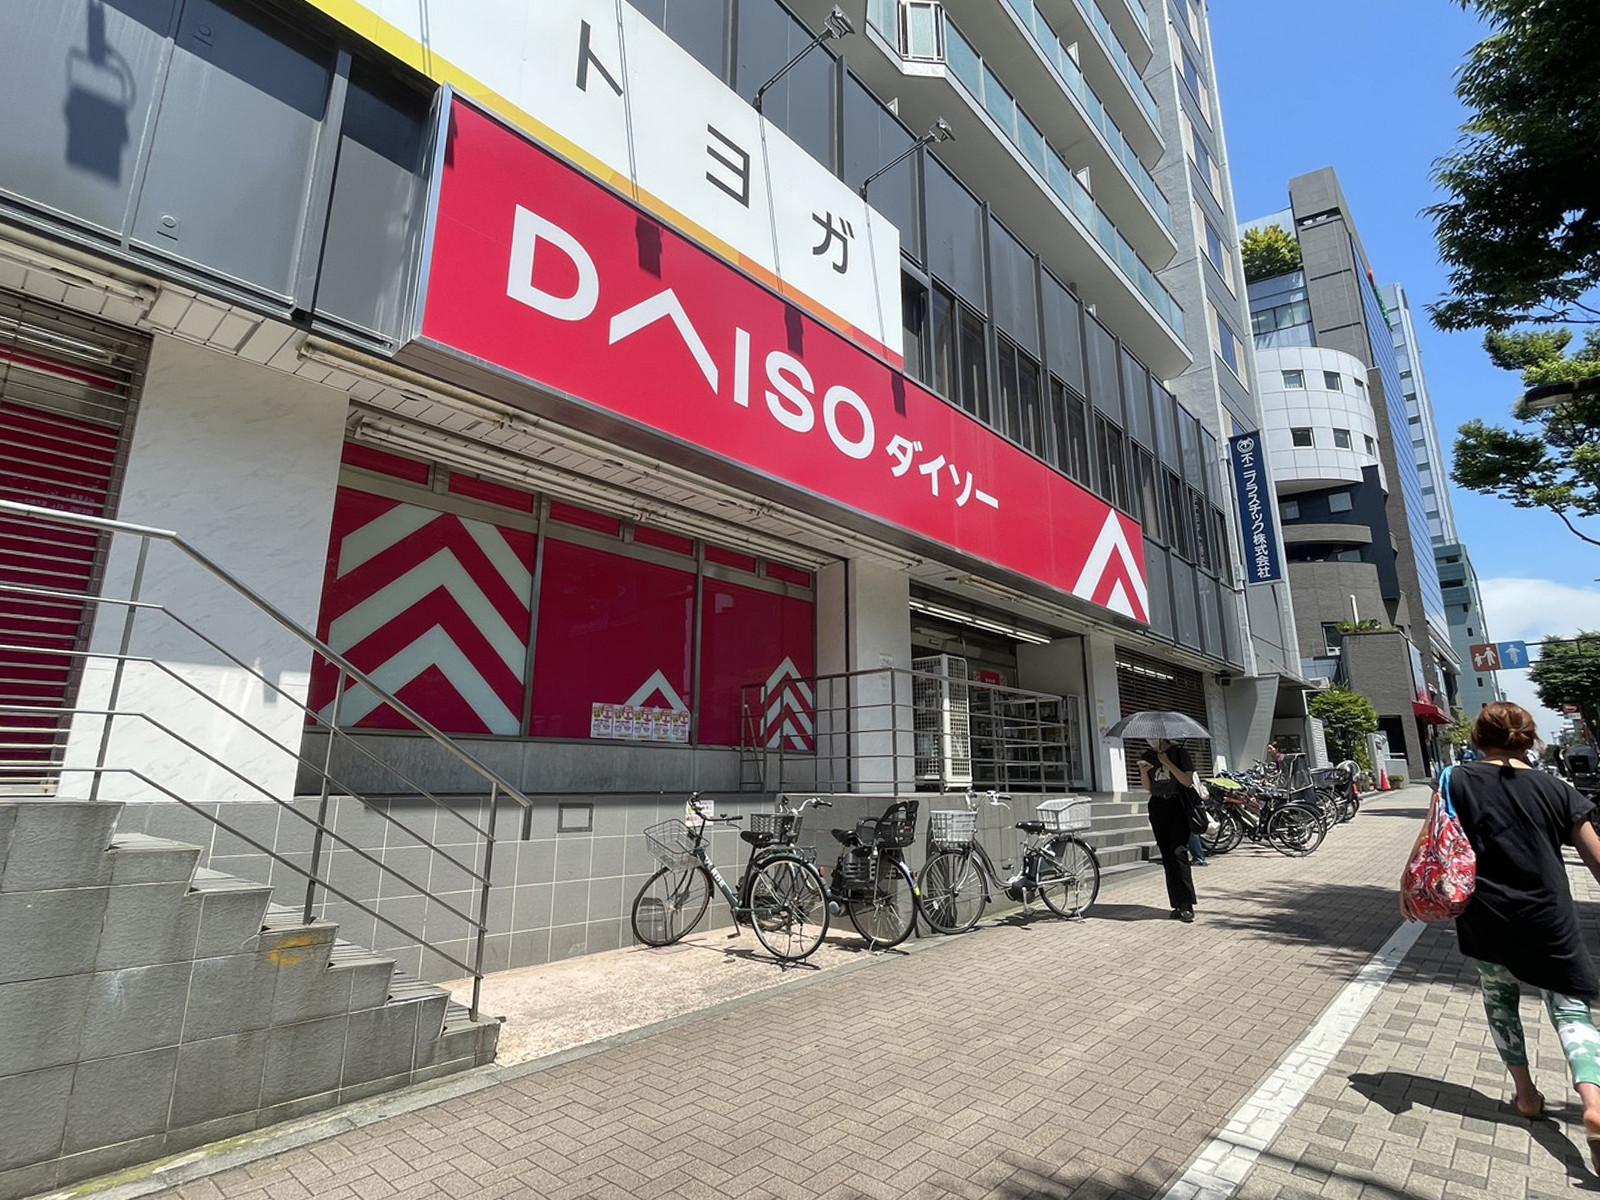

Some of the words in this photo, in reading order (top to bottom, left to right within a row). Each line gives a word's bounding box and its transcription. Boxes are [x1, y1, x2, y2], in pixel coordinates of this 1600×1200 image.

[506, 203, 875, 460] DAISO
[885, 433, 999, 509] ダイソー
